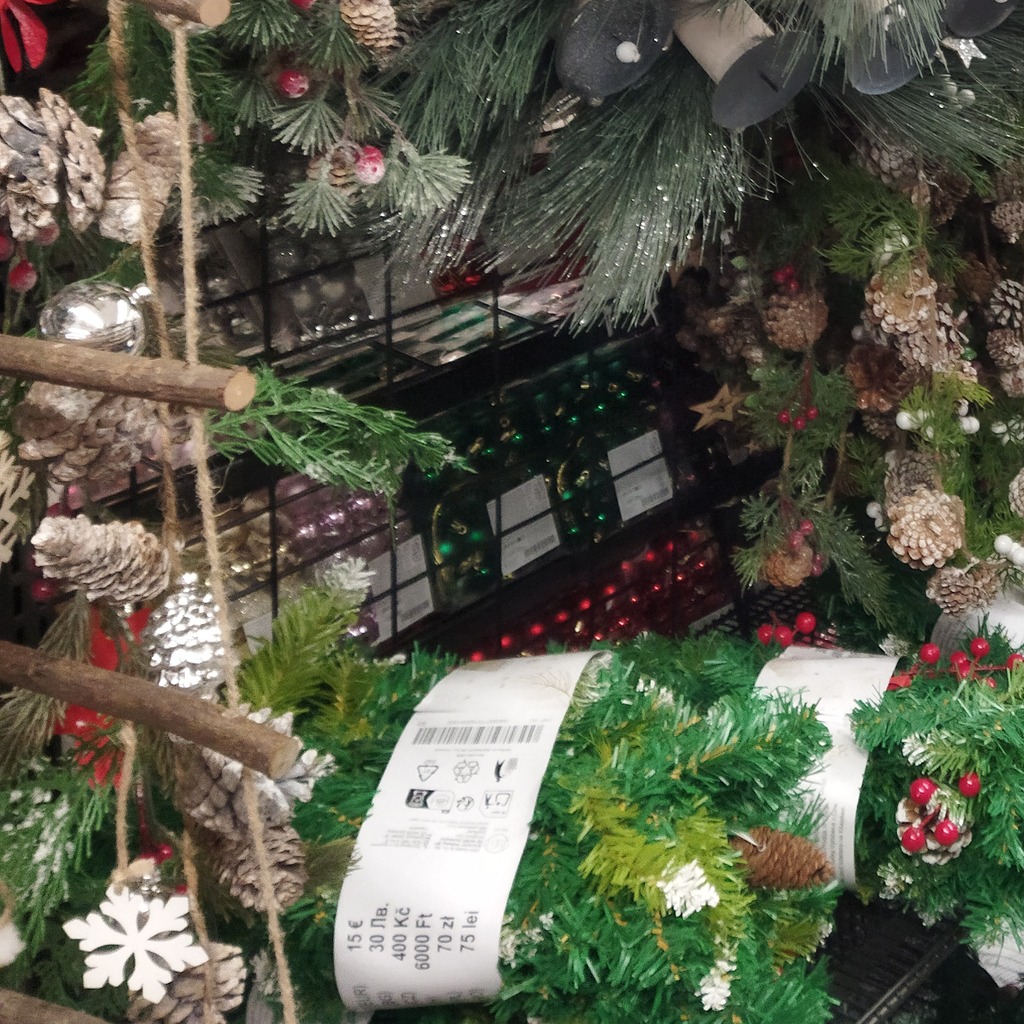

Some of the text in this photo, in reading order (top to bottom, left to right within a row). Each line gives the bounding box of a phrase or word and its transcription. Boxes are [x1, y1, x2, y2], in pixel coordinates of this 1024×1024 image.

[347, 920, 363, 951] 15 €
[369, 934, 384, 952] 30
[392, 907, 410, 961] 400 Kč
[414, 913, 433, 970] 6000 Ft
[437, 916, 454, 952] 70 zł
[460, 911, 479, 952] 75 lei
